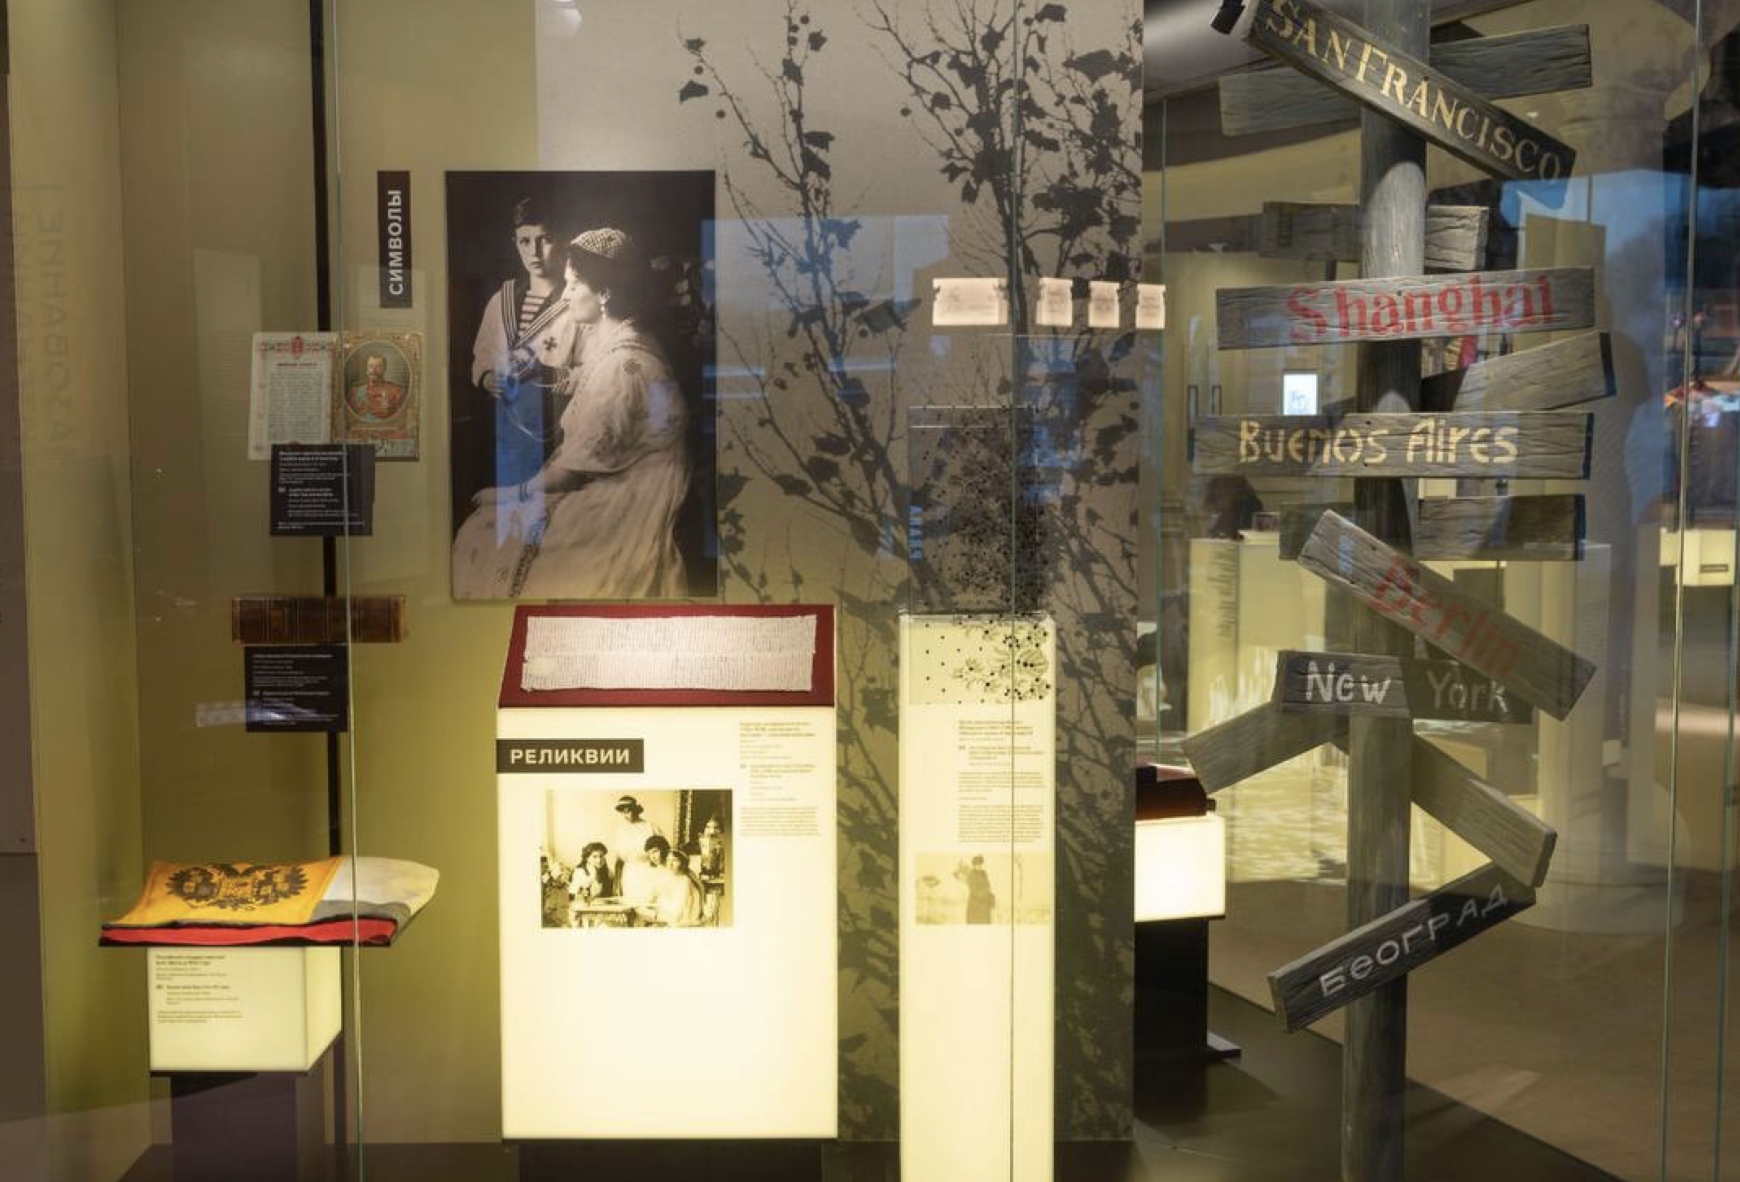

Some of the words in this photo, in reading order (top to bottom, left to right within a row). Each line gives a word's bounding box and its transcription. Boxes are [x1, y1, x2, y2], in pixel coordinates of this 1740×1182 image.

[1265, 0, 1351, 71] SAN
[1354, 44, 1561, 182] FRANCISCO
[387, 189, 404, 295] СИМВОЛЫ
[1287, 274, 1555, 341] Shanghai
[1239, 419, 1390, 465] Buenos
[1405, 417, 1519, 465] Aires
[1368, 555, 1522, 677] Berlin
[1305, 659, 1392, 705] New
[1427, 669, 1509, 714] York
[510, 748, 630, 765] РЕЛИКВИИ
